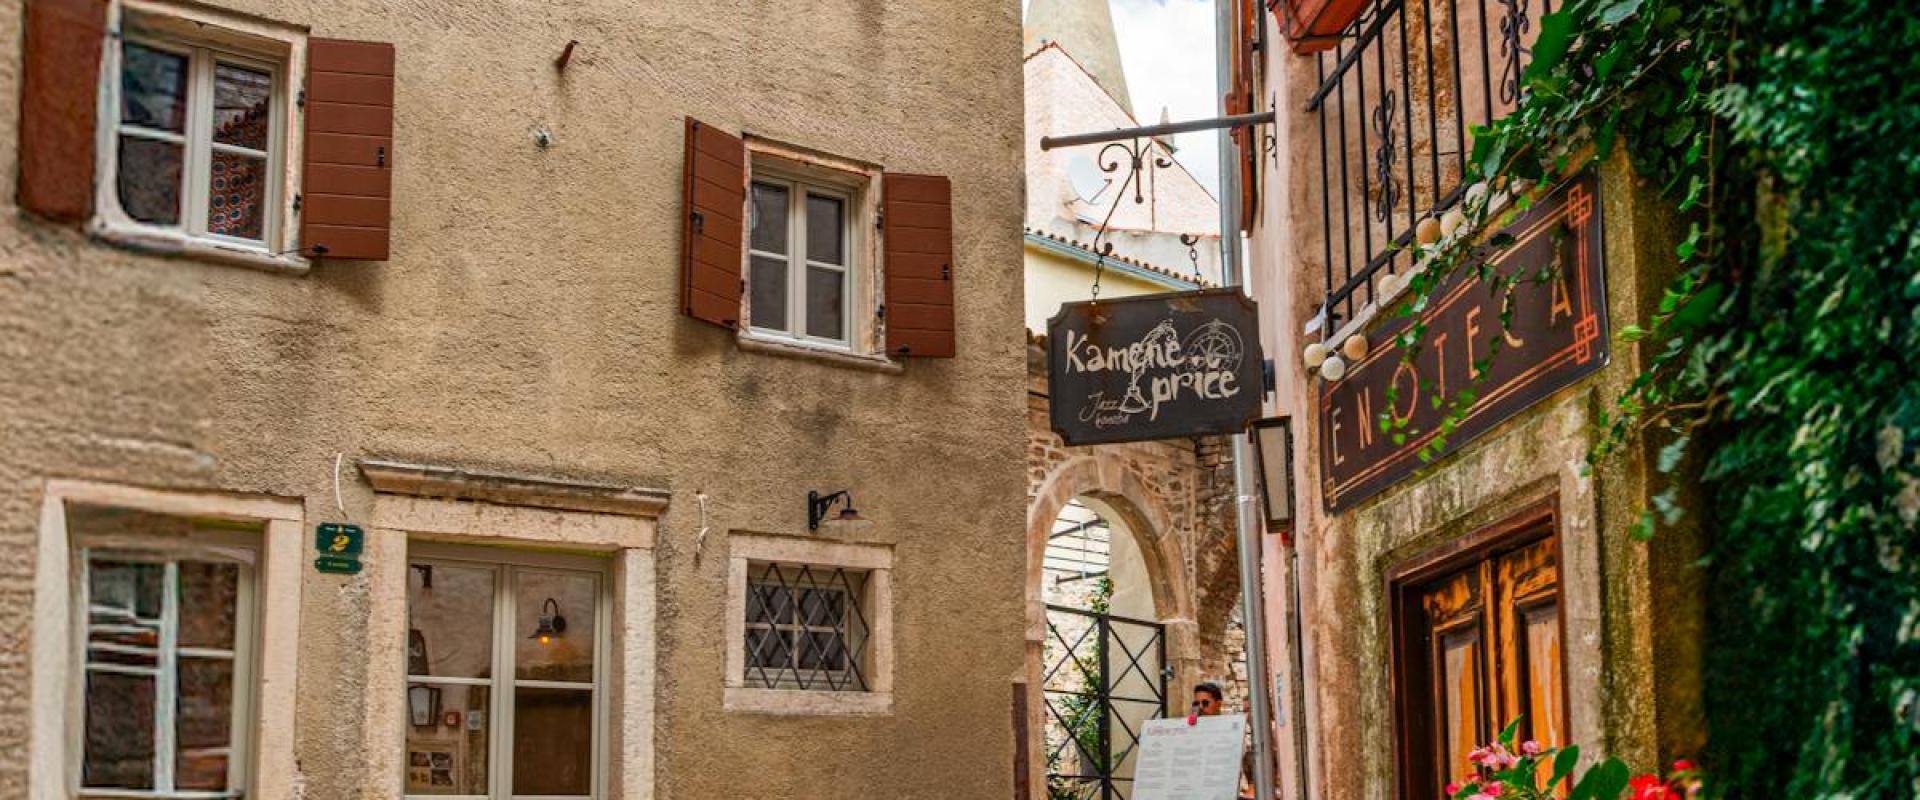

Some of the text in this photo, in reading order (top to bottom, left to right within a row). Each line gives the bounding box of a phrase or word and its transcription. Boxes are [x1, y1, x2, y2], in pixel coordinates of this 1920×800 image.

[1064, 329, 1185, 375] Kamene
[1330, 256, 1573, 466] ENOTECA
[328, 535, 350, 552] 2
